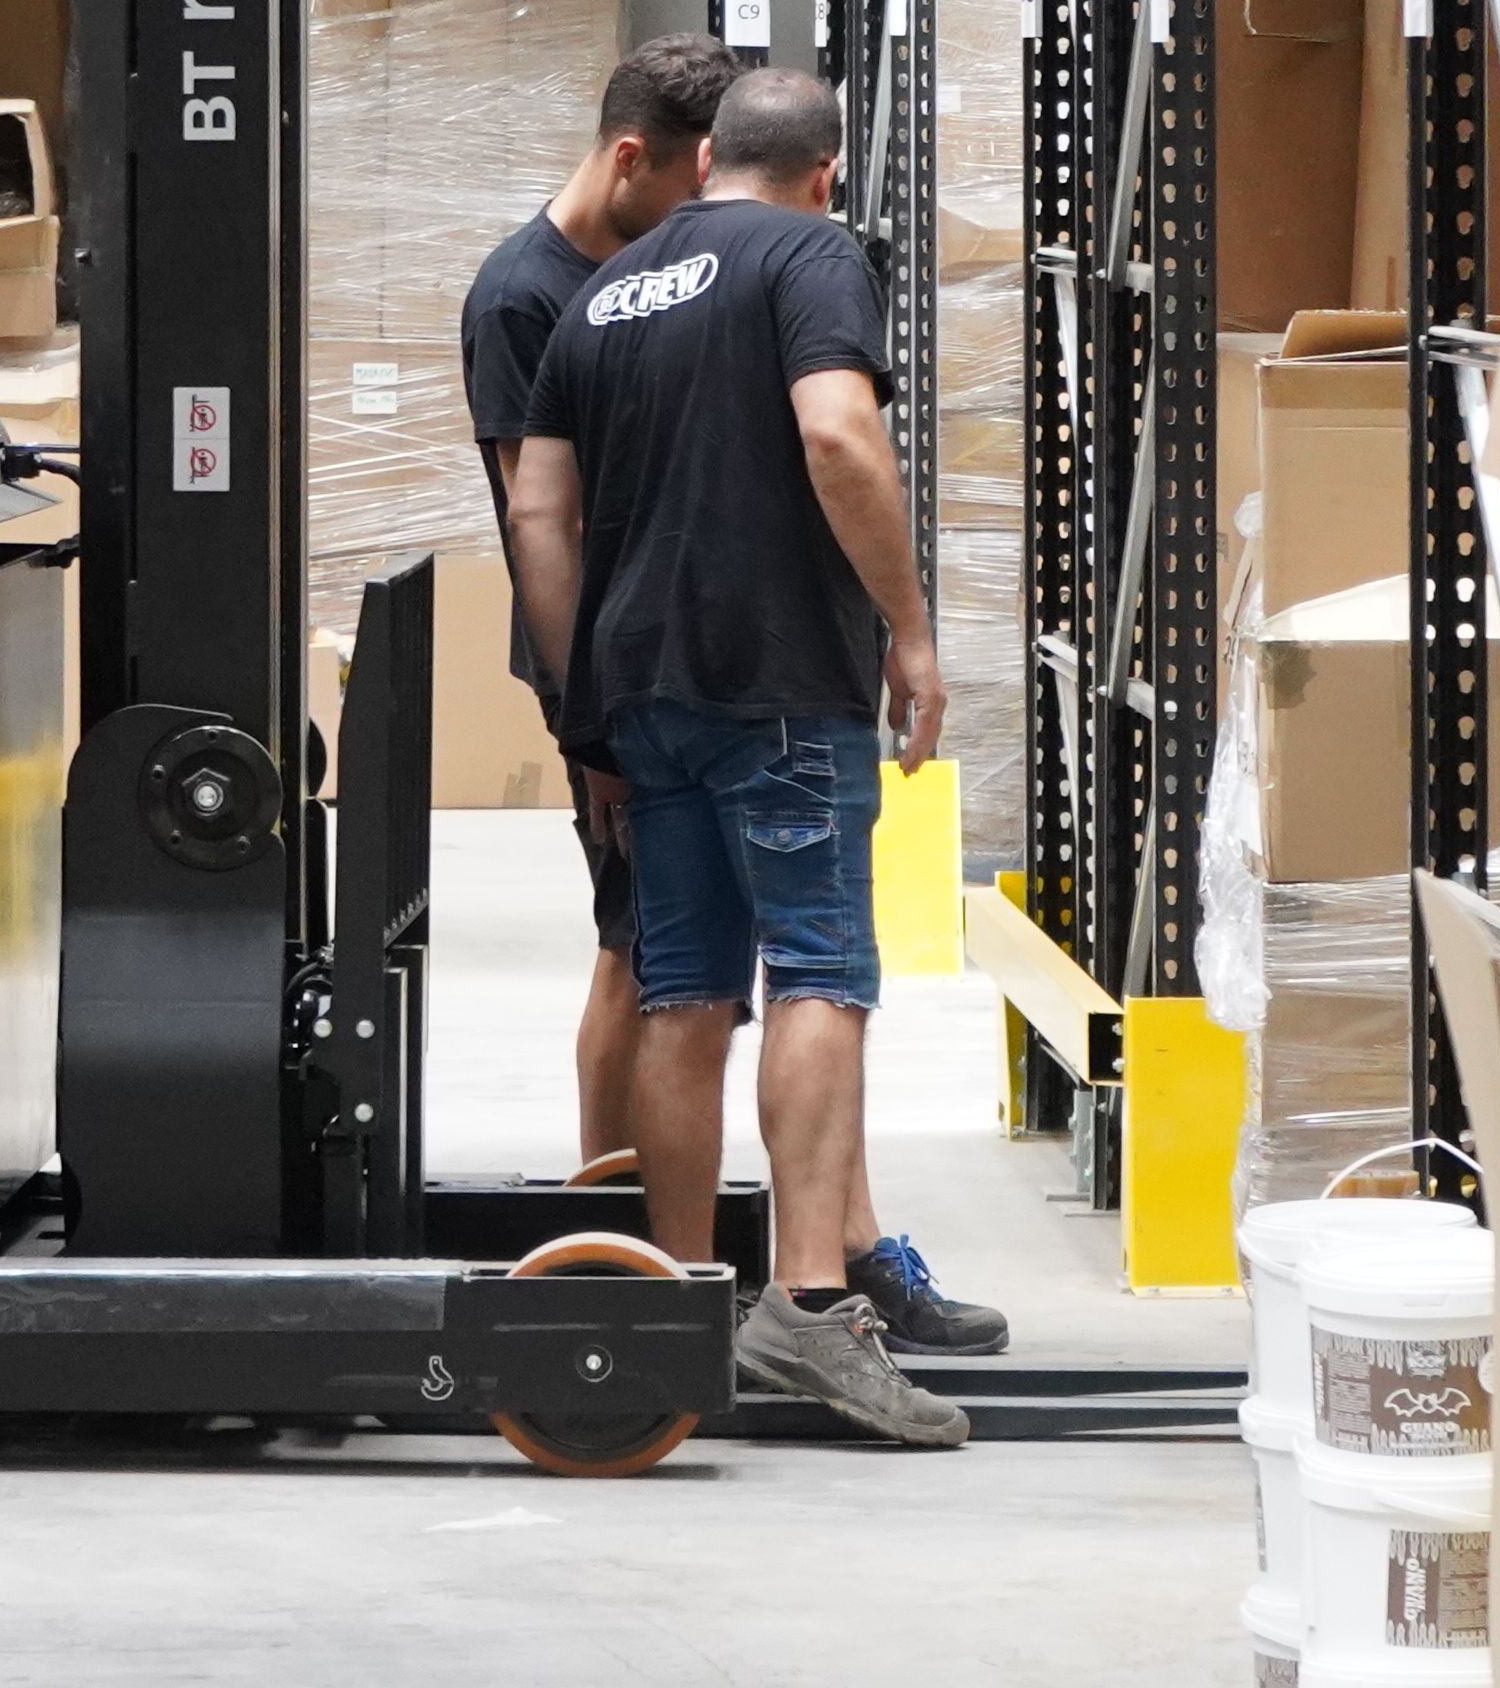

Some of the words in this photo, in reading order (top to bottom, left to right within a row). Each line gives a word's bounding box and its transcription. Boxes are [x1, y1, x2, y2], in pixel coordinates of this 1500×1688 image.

[738, 4, 760, 20] C9
[182, 50, 237, 142] BT
[620, 257, 709, 315] CREW
